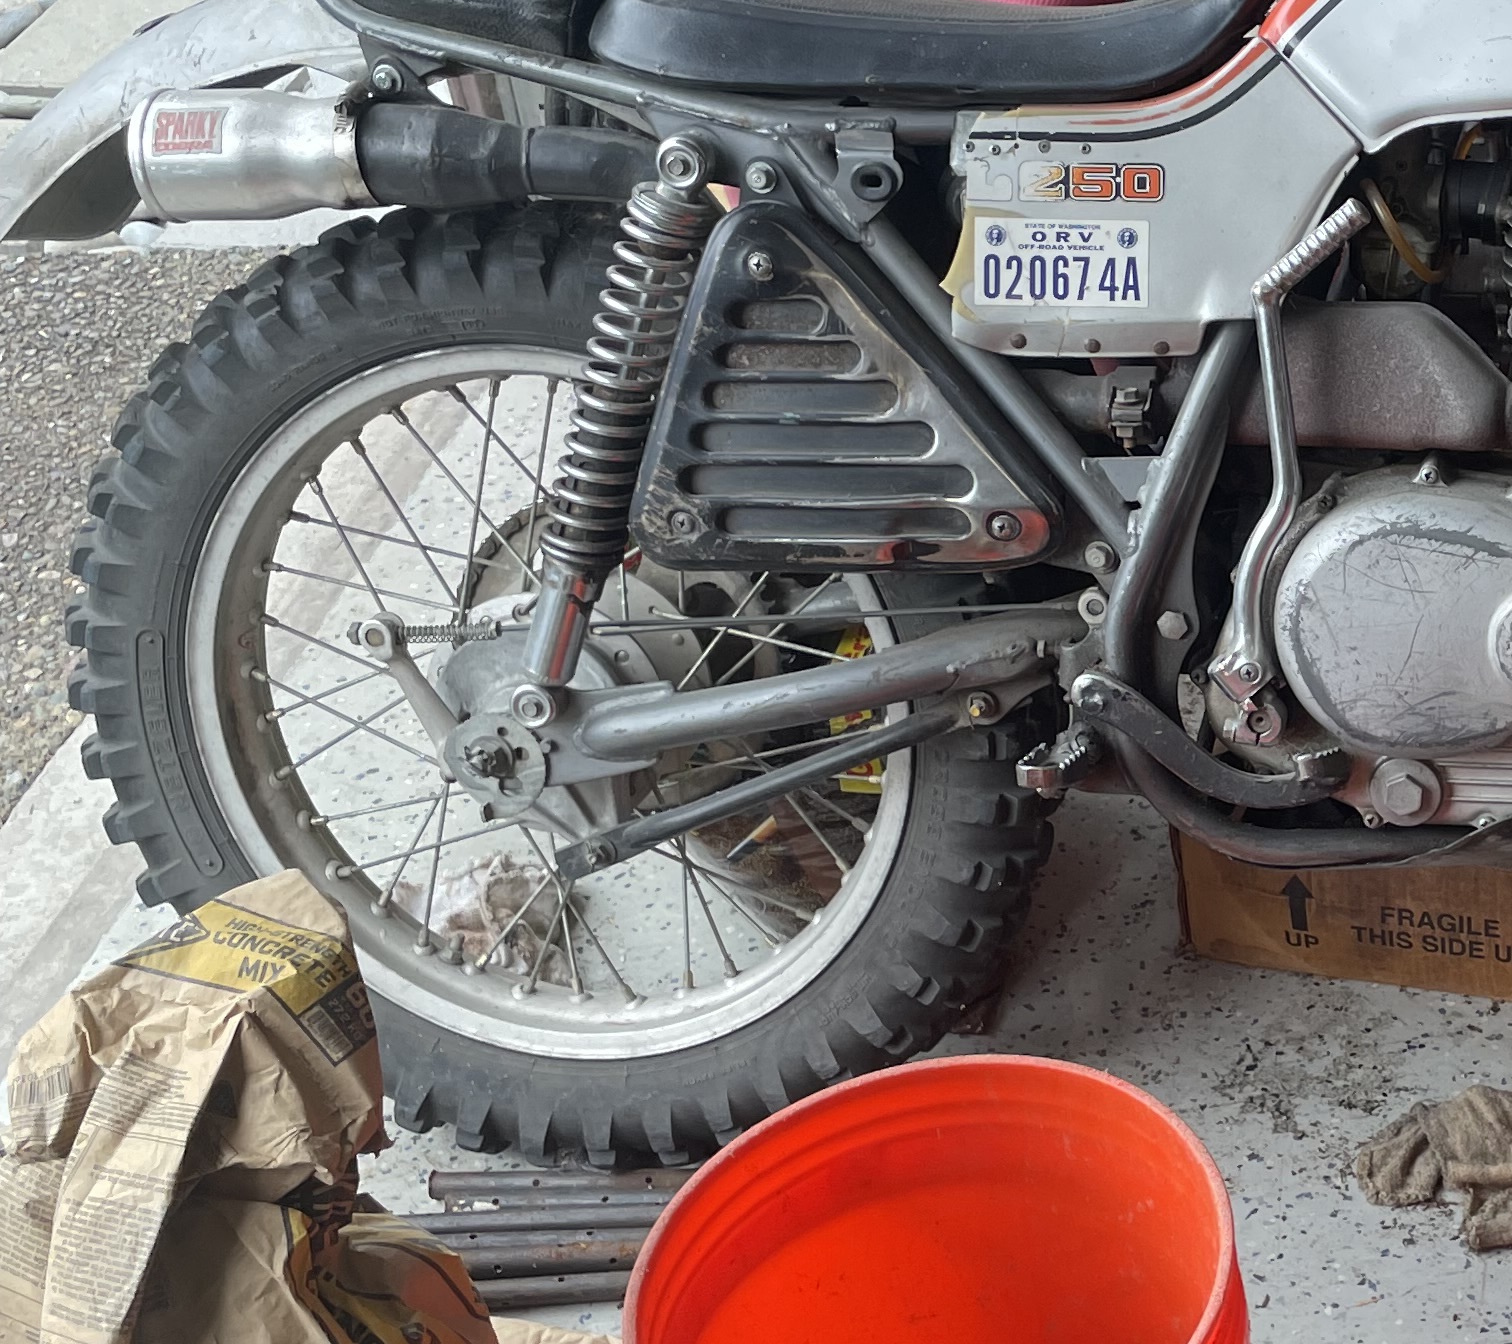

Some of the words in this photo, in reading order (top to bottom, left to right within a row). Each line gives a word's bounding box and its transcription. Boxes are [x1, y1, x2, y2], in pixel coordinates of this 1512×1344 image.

[983, 253, 1141, 302] 020674A
[1380, 906, 1500, 938] FRAGILE
[1284, 930, 1320, 949] UP
[1351, 926, 1413, 950] THIS
[1422, 934, 1486, 959] SIDE
[213, 931, 336, 989] CONCRETE
[237, 957, 286, 983] MIX
